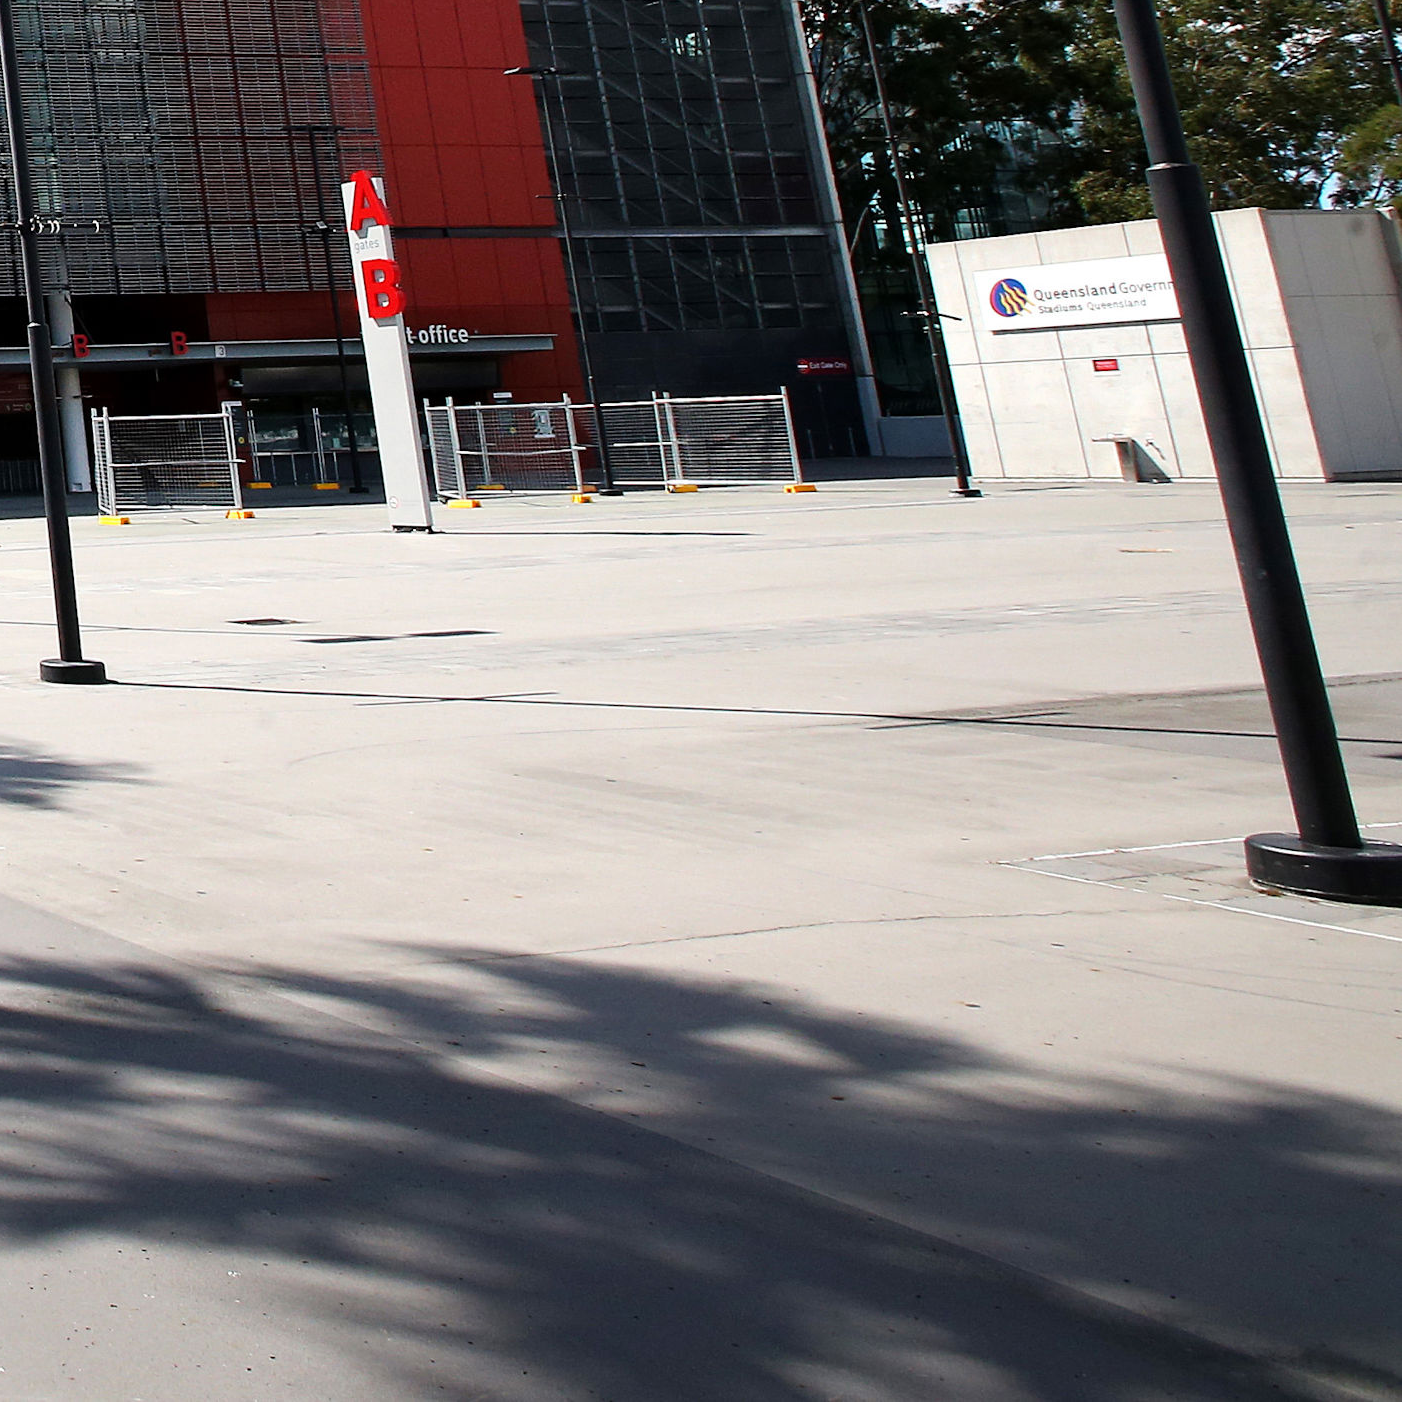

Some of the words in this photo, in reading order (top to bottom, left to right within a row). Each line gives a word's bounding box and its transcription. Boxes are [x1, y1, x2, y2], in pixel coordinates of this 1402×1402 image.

[350, 170, 394, 230] A
[354, 239, 380, 254] gates
[361, 259, 406, 319] B
[1034, 282, 1116, 301] Queensland
[1038, 305, 1083, 314] Stadiums
[1087, 299, 1147, 311] Queensland
[73, 334, 90, 358] B
[171, 331, 188, 355] B
